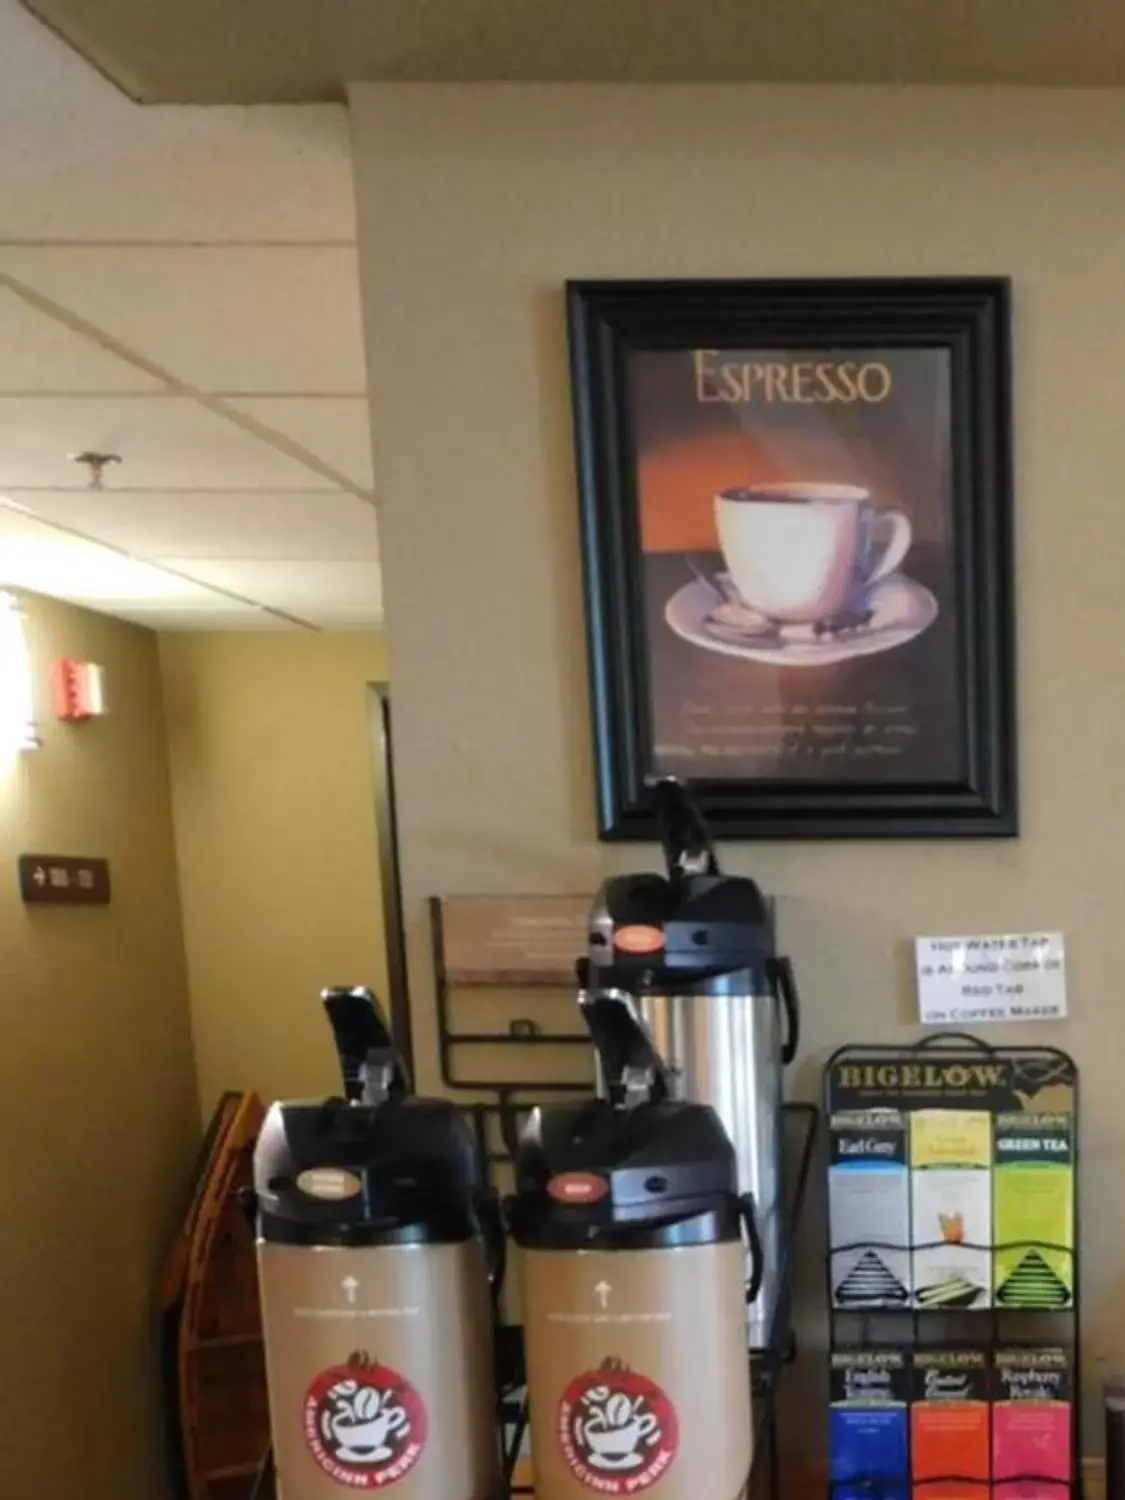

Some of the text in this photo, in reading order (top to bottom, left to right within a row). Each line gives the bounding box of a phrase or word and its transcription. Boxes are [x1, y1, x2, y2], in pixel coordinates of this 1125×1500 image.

[694, 349, 892, 404] ESPRESSO
[838, 1065, 1004, 1088] BIGELOW
[998, 1138, 1068, 1152] GREEN TEA
[374, 1443, 421, 1483] PERK
[625, 1451, 672, 1490] PERK
